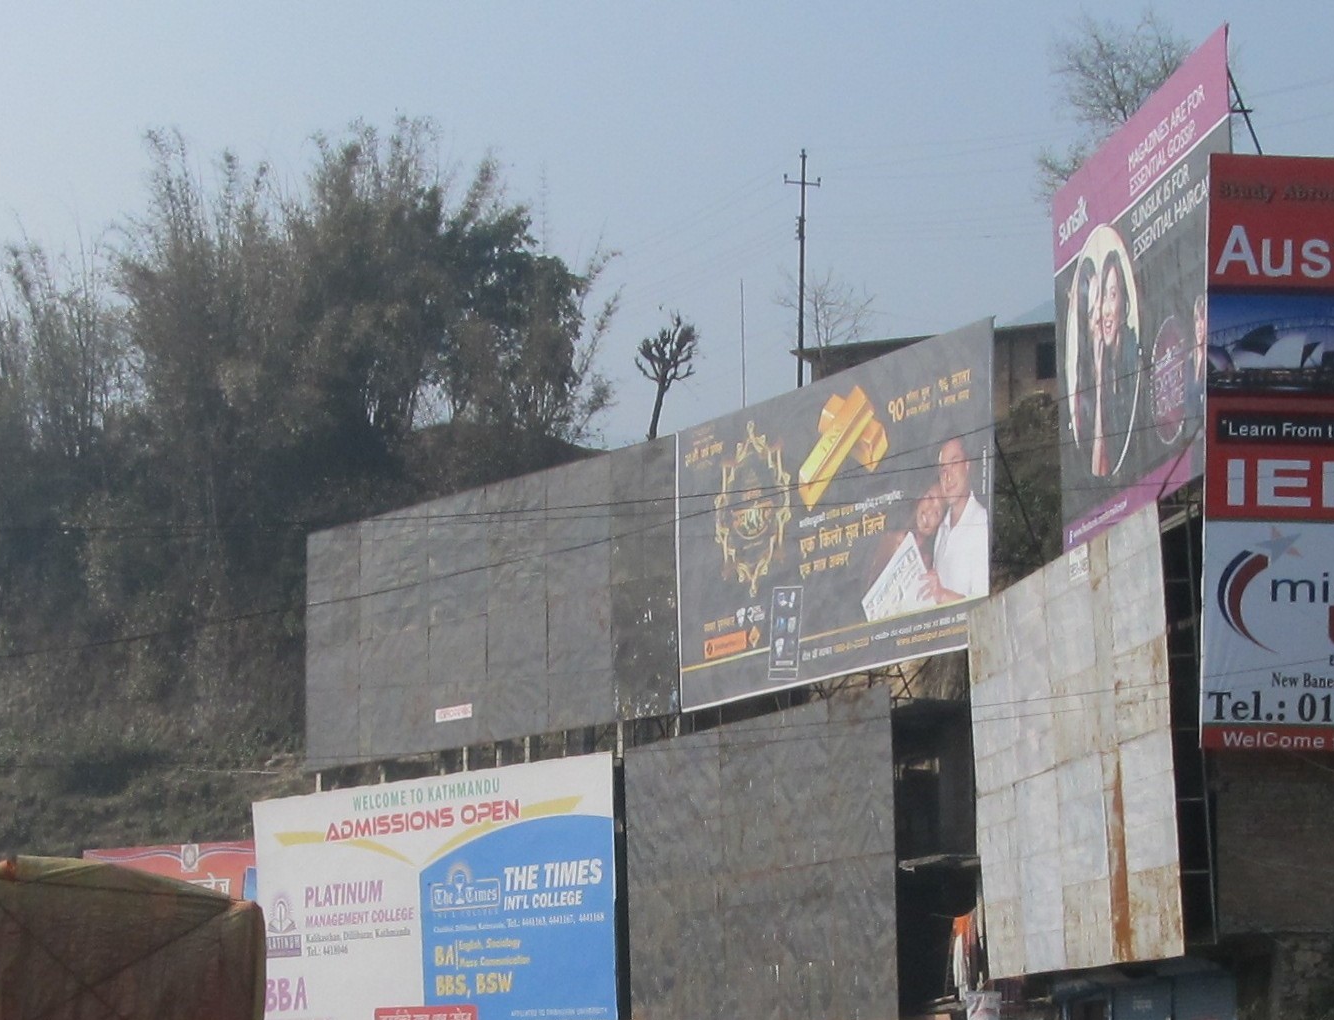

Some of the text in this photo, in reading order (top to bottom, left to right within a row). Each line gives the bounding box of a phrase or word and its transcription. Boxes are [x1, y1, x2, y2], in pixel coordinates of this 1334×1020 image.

[1128, 84, 1205, 172] MAGAZINES ARE FOR
[1163, 179, 1171, 202] IS
[1172, 164, 1190, 194] FOR
[1282, 422, 1322, 438] From
[1271, 672, 1298, 688] New
[1208, 691, 1286, 721] Tel.:
[1223, 731, 1324, 750] WelCome
[352, 778, 501, 812] WELCOME TO KATHMANDU
[325, 799, 520, 842] ADMISSIONS OPEN
[504, 858, 603, 892] THE TIMES
[305, 880, 383, 908] PLATINUM
[433, 885, 498, 905] The Times
[504, 889, 583, 911] INT'L COLLEGE
[305, 907, 414, 928] MANAGEMENT COLLEGE
[435, 945, 454, 966] BA
[436, 971, 513, 998] BBS, BSW
